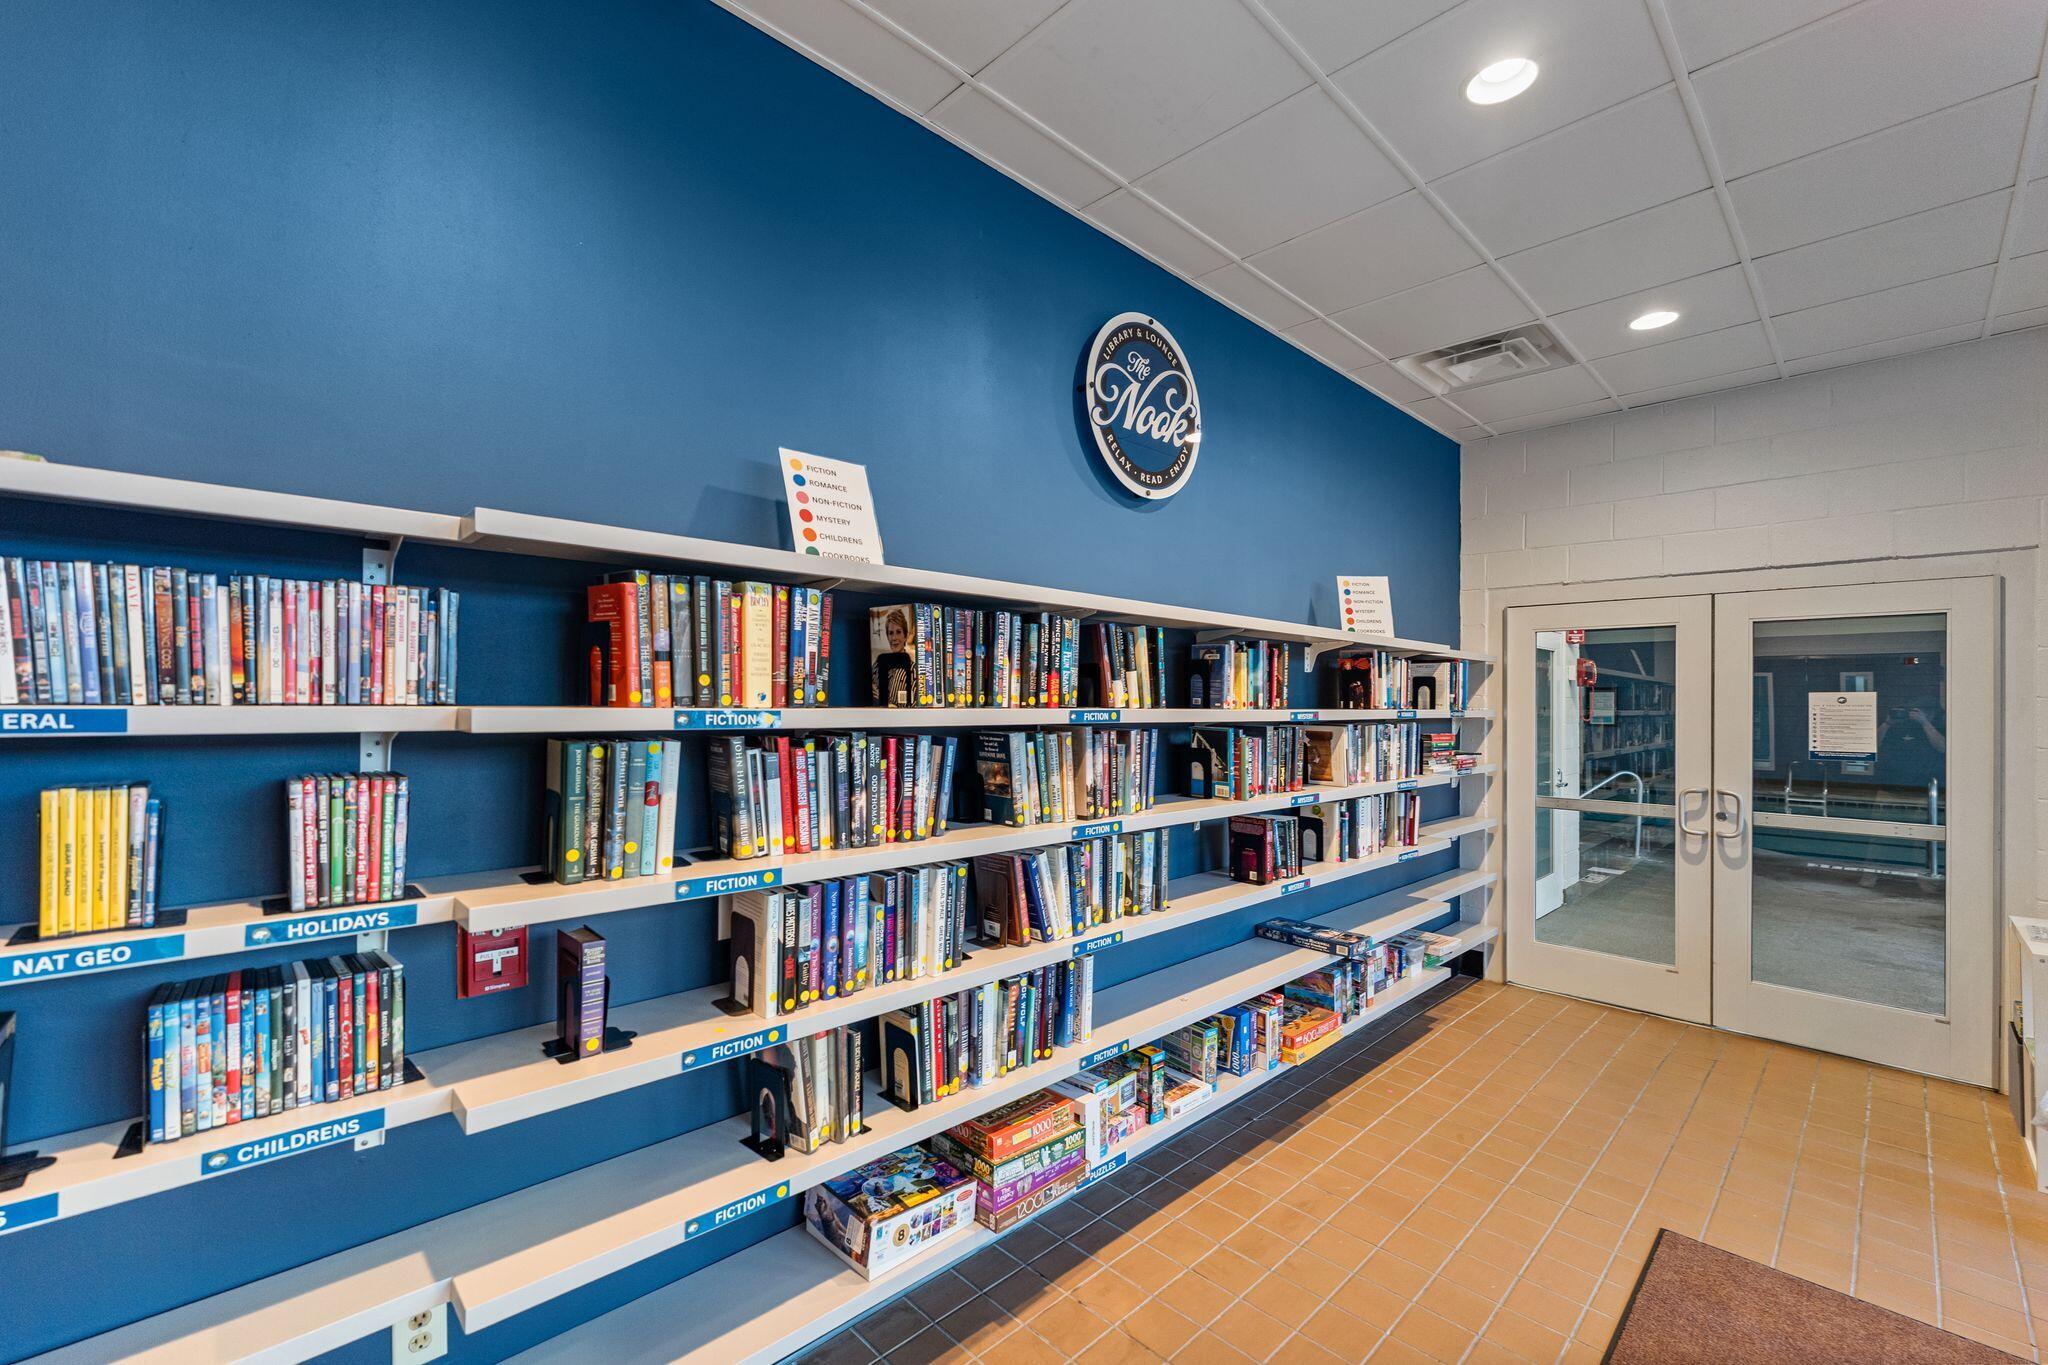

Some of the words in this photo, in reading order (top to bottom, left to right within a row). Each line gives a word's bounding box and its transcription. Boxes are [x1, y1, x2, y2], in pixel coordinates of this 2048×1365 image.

[1102, 328, 1134, 360] LIBRARY
[1136, 328, 1143, 338] &
[1145, 330, 1178, 367] LOUNGE
[1127, 351, 1150, 381] The
[1091, 362, 1197, 448] Nook
[806, 464, 837, 477] FICTION
[1106, 433, 1132, 472] RELAX
[1140, 472, 1163, 485] READ
[1169, 447, 1190, 478] ENJOY
[809, 479, 847, 493] ROMANCE
[812, 496, 863, 511] NON-FICTION
[816, 515, 851, 526] MYSTERY
[819, 532, 863, 545] CHILDRENS
[822, 551, 870, 564] COOKBOOKS
[244, 604, 255, 628] CITY
[794, 596, 802, 631] BERENSON
[809, 607, 818, 621] JAN
[823, 596, 831, 630] CATHERINE
[640, 618, 649, 638] BARR
[809, 622, 818, 647] BURKE
[917, 616, 925, 643] PATRICIA
[244, 639, 255, 660] GOD
[641, 643, 650, 660] THE
[821, 630, 829, 657] COULTER
[918, 643, 926, 674] CORNWELL
[1063, 651, 1073, 668] PLUM
[642, 661, 651, 681] ROPE
[1062, 670, 1071, 694] ISLAND
[2, 713, 75, 730] ERAL
[705, 714, 757, 726] FICTION
[1084, 712, 1109, 721] FICTION
[733, 740, 744, 767] JOHN
[905, 742, 914, 757] FAYE
[591, 757, 602, 790] LICAN
[620, 761, 628, 782] STREET
[796, 755, 805, 770] IRIS
[736, 770, 746, 796] HART
[797, 770, 807, 805] JOHANSEN
[904, 758, 914, 797] KELLERMAN
[591, 792, 601, 817] BRIEF
[618, 784, 627, 808] LAWYER
[305, 796, 314, 824] Holiday
[358, 795, 367, 822] Holiday
[384, 796, 393, 823] Holiday
[615, 812, 625, 832] JOHN
[739, 809, 749, 846] UNWILLING
[799, 808, 809, 845] QUICKSAND
[1085, 824, 1111, 836] FICTION
[306, 825, 314, 863] Collector's
[359, 823, 367, 860] Collector's
[384, 823, 393, 860] Collector's
[306, 863, 314, 876] Set
[359, 860, 367, 873] Set
[384, 861, 393, 873] Set
[706, 874, 758, 893] FICTION
[786, 898, 795, 914] JAMES
[287, 912, 390, 939] HOLIDAYS
[771, 920, 779, 954] Quindlen
[785, 914, 795, 948] PATTERSON
[498, 949, 515, 957] DOWN
[1087, 937, 1112, 951] FICTION
[12, 953, 70, 978] NAT
[75, 945, 132, 968] GEO
[801, 962, 809, 986] Guilty
[341, 1020, 352, 1059] Cars
[381, 1010, 389, 1047] RATATOUILLE
[712, 1035, 764, 1060] FICTION
[1093, 1046, 1119, 1062] FICTION
[1231, 1051, 1239, 1076] 1000
[1032, 1118, 1052, 1136] 1000
[237, 1118, 360, 1164] CHILDRENS
[1064, 1132, 1082, 1151] 1000
[974, 1157, 991, 1175] 1000
[1090, 1160, 1117, 1181] PUZZLES
[1001, 1185, 1012, 1195] The
[714, 1194, 767, 1226] FICTION
[897, 1229, 905, 1241] 8
